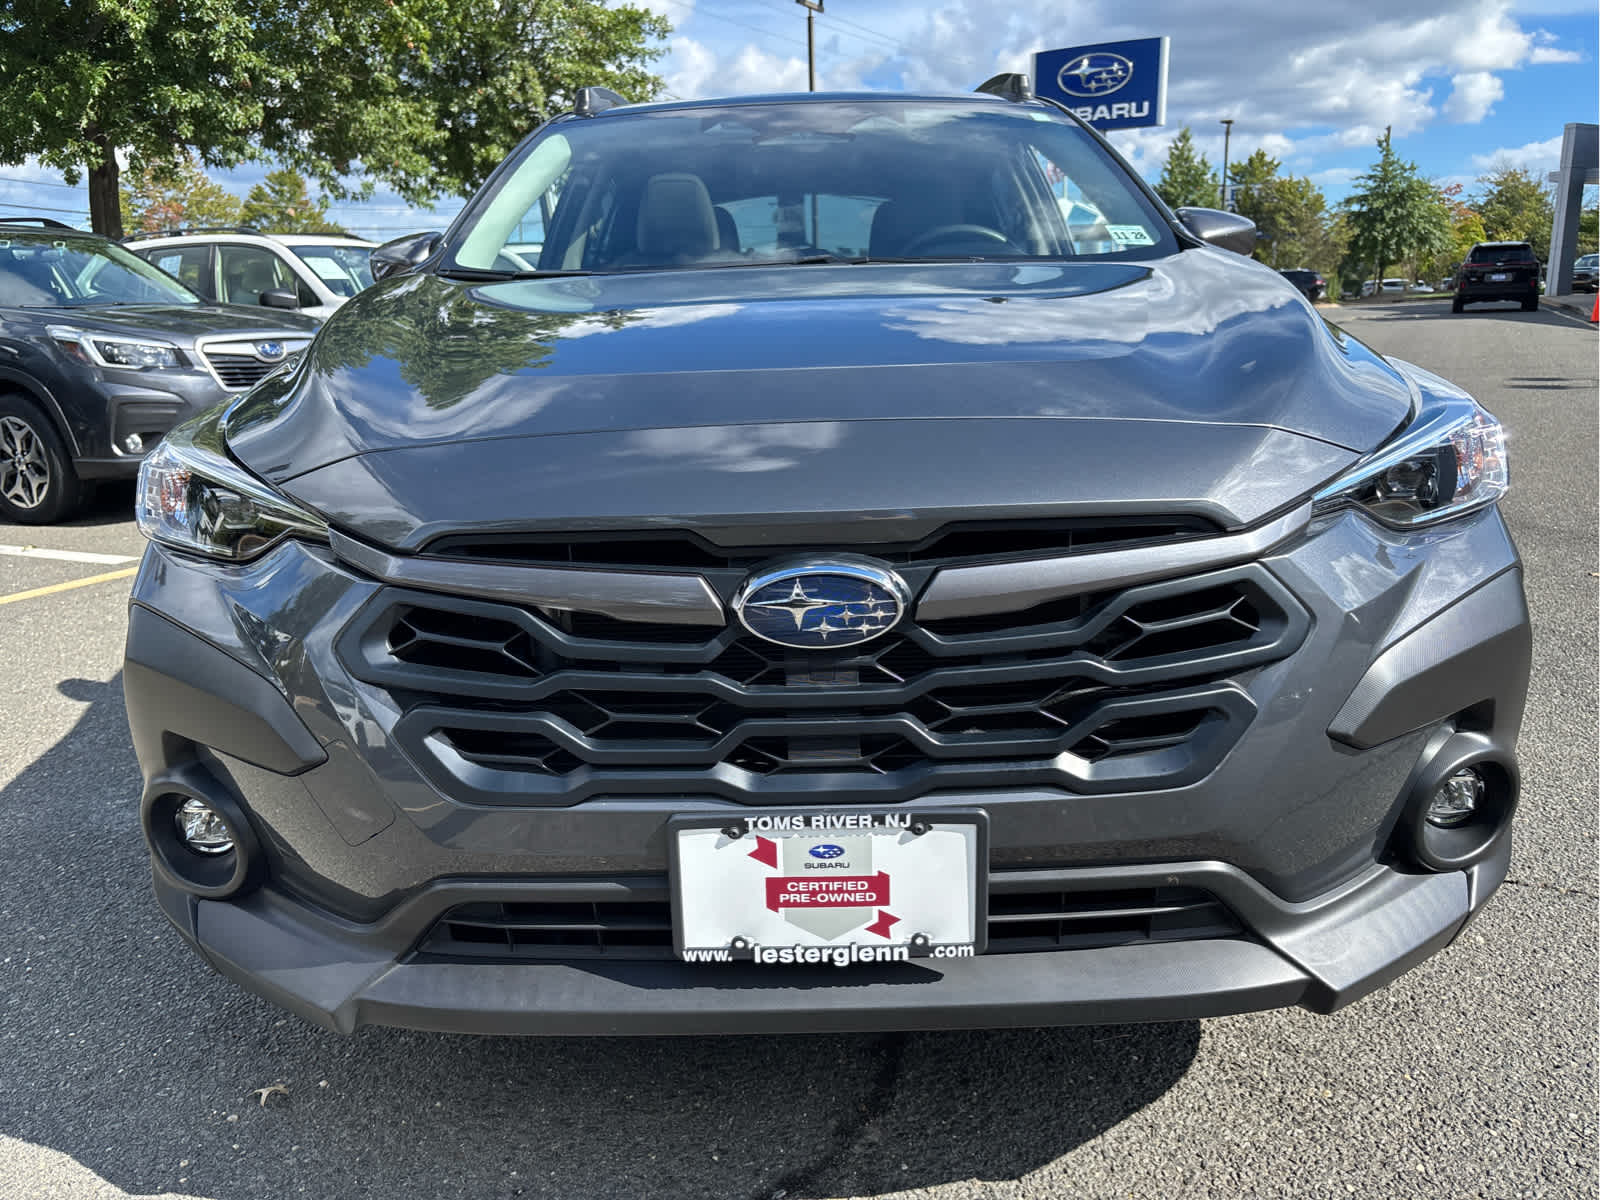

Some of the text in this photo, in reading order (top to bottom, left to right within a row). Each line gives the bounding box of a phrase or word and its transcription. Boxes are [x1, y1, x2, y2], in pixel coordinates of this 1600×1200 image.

[1072, 101, 1149, 121] BARU
[1113, 231, 1130, 240] 11
[744, 812, 912, 831] TOMS RIVER, NJ
[786, 881, 869, 891] CERTIFIED
[779, 892, 877, 903] PRE-OWNED
[682, 944, 975, 967] www. lesterglenn .com
